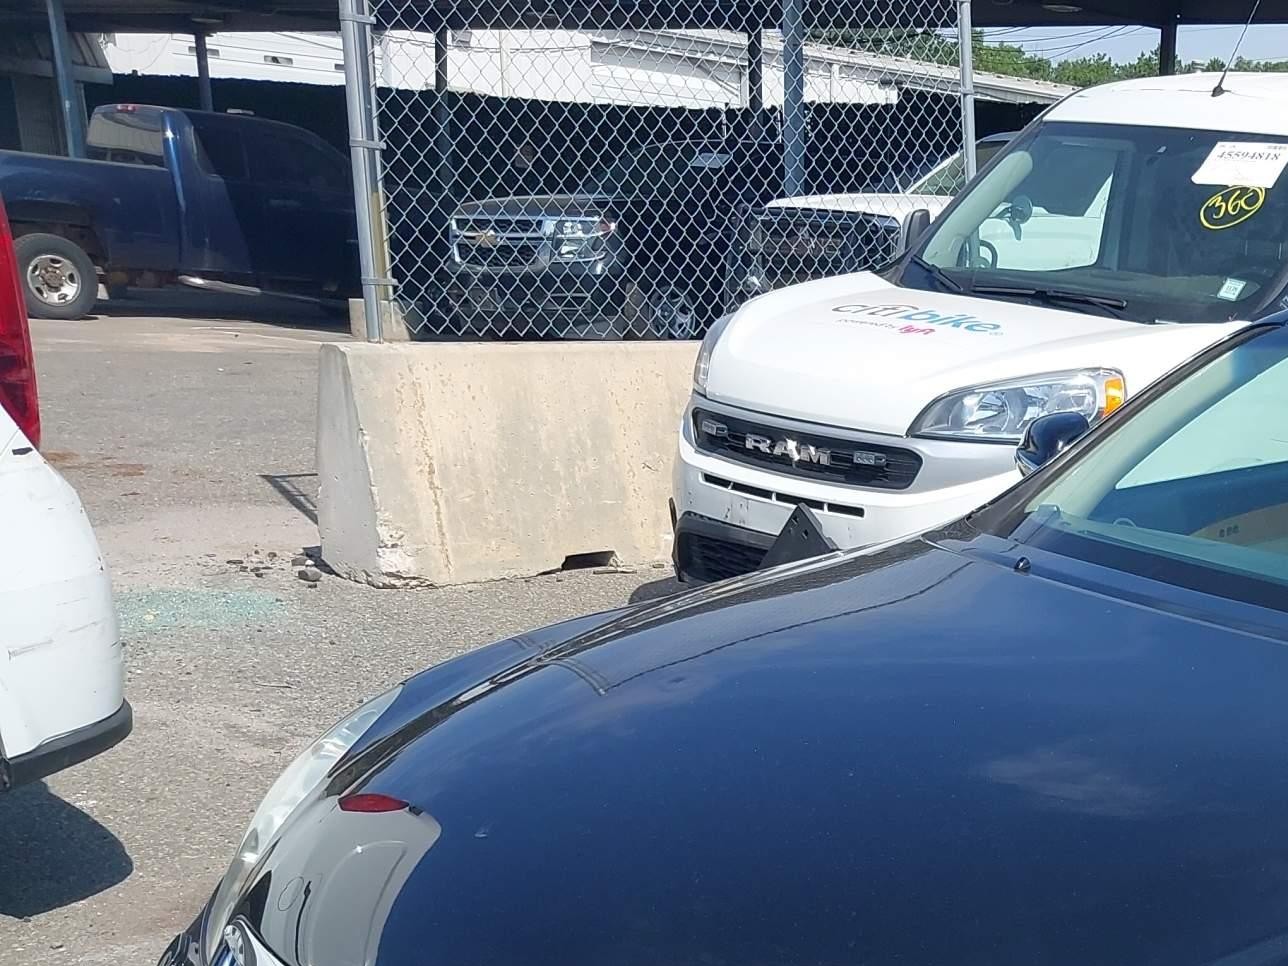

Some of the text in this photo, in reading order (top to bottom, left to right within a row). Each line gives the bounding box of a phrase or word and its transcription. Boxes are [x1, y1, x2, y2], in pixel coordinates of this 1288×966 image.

[1217, 150, 1281, 161] 45594818
[1209, 190, 1263, 219] 360
[897, 310, 1002, 332] bike
[745, 433, 831, 466] RAM
